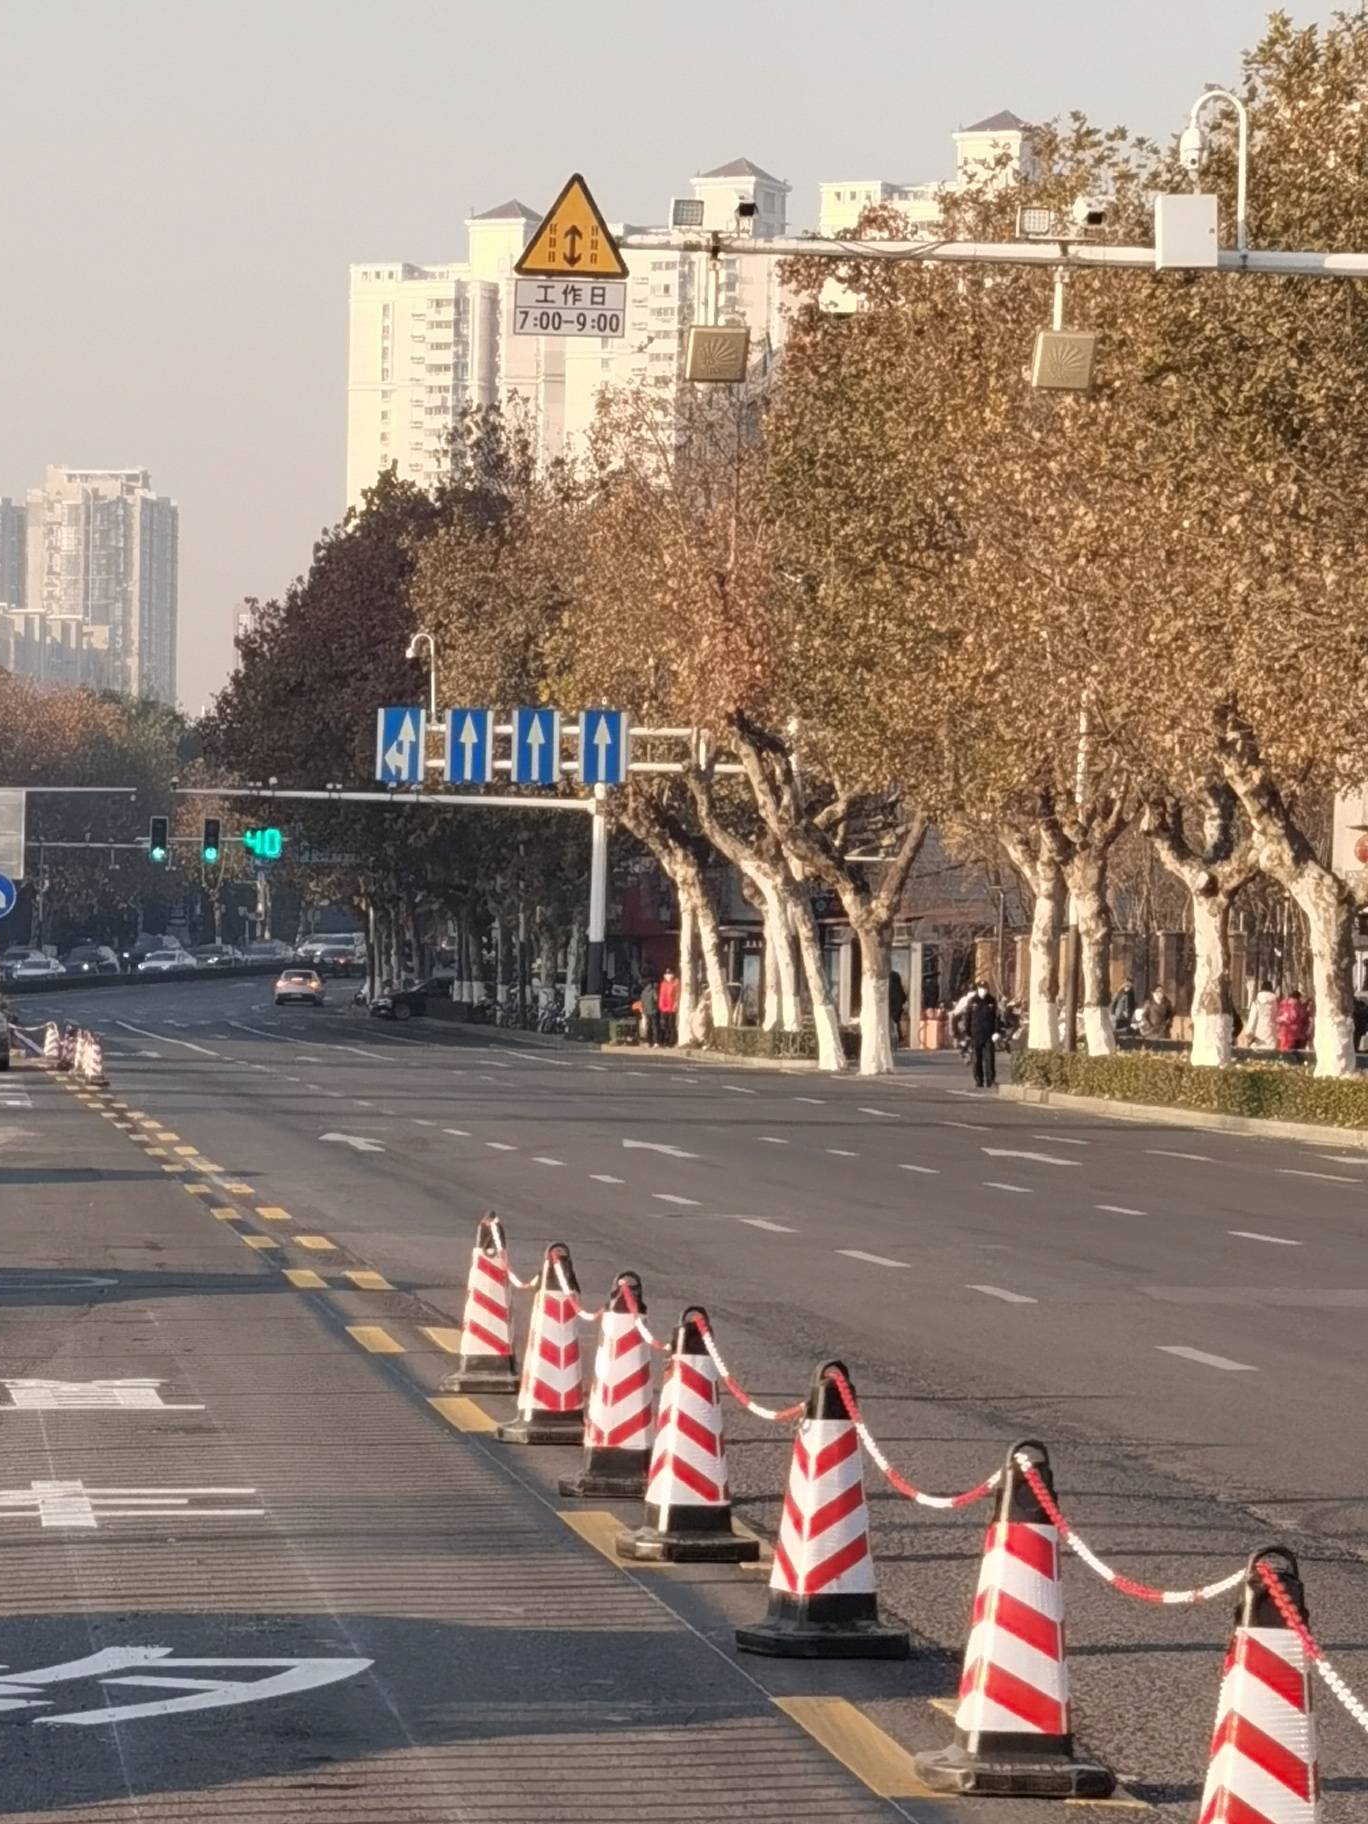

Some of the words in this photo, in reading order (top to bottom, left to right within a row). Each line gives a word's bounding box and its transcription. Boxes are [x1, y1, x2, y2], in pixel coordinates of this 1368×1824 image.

[535, 284, 607, 306] 工作日
[518, 310, 621, 333] 7:00-9:00
[244, 827, 282, 858] 40
